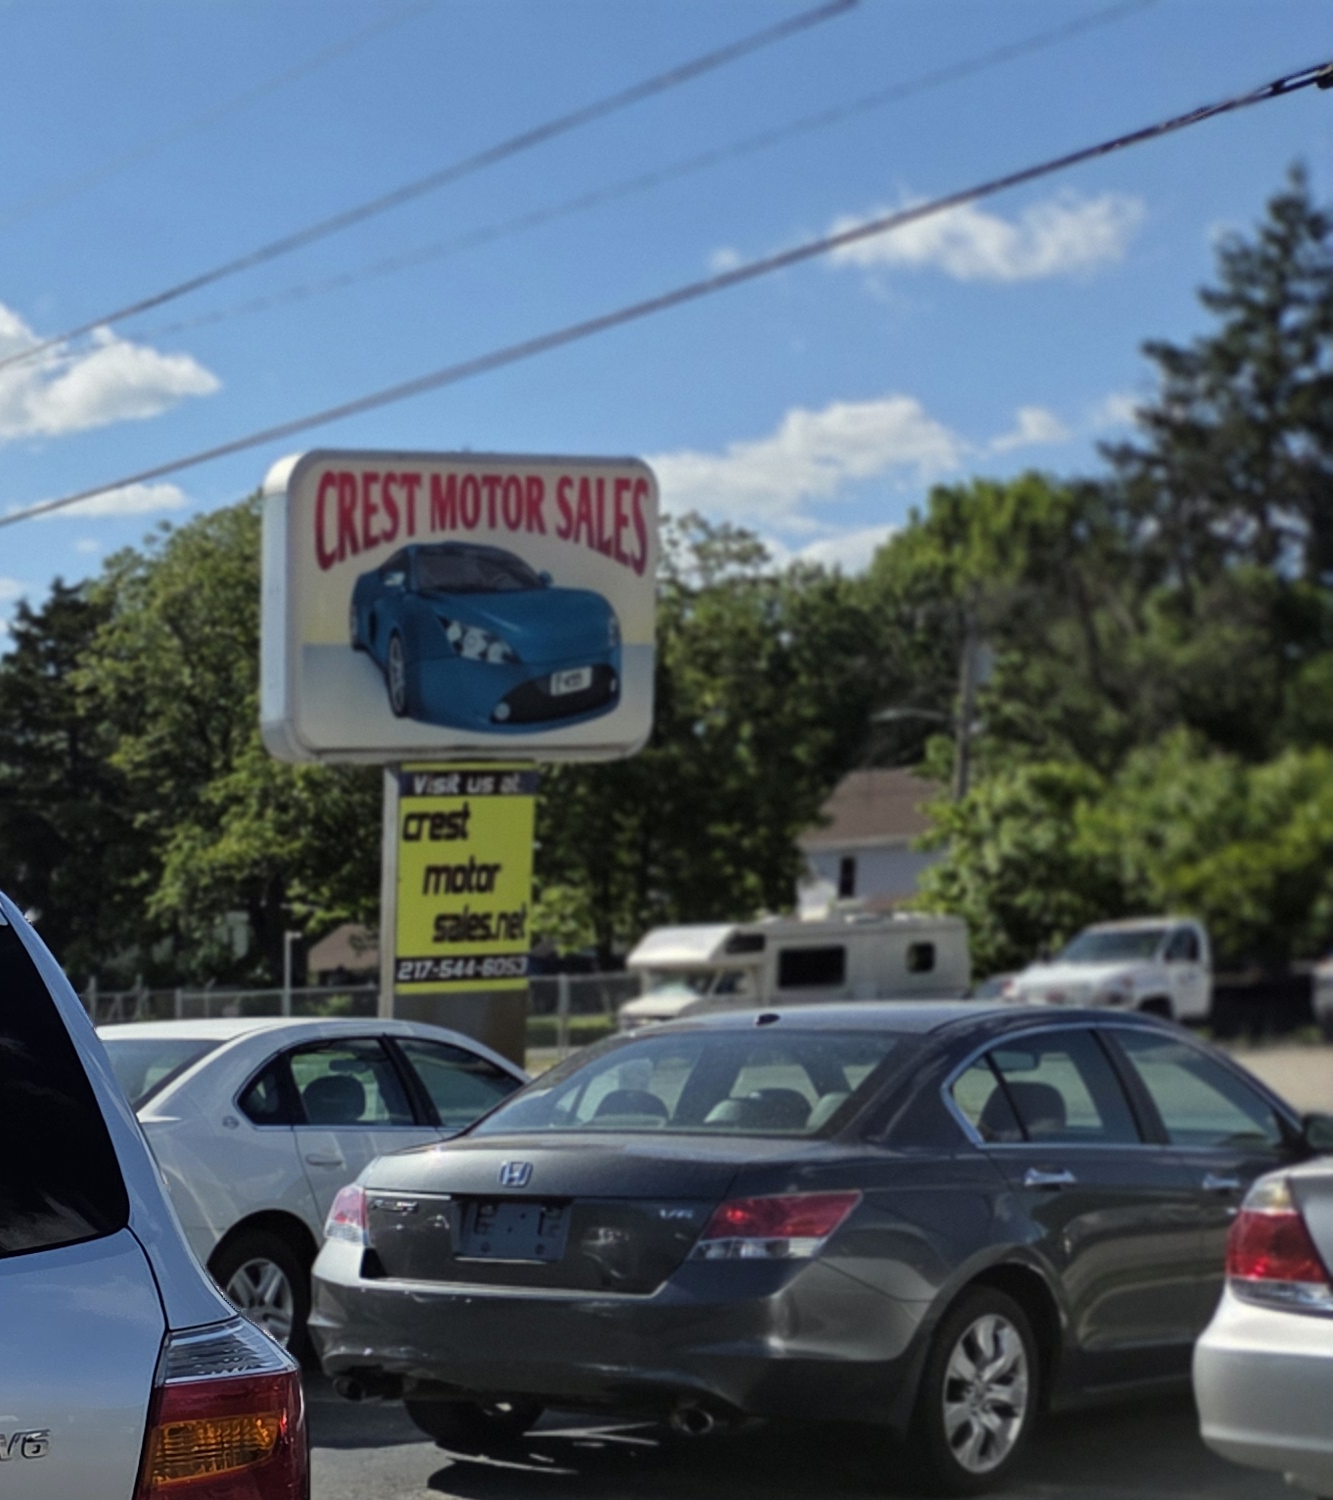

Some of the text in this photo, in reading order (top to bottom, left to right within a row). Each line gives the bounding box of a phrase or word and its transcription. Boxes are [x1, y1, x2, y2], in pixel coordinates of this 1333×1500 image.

[314, 469, 649, 577] CREST MOTOR SALES
[413, 772, 460, 795] Visit
[466, 776, 495, 794] us
[403, 801, 471, 842] crest
[423, 855, 502, 896] motor
[431, 902, 529, 944] sales.net
